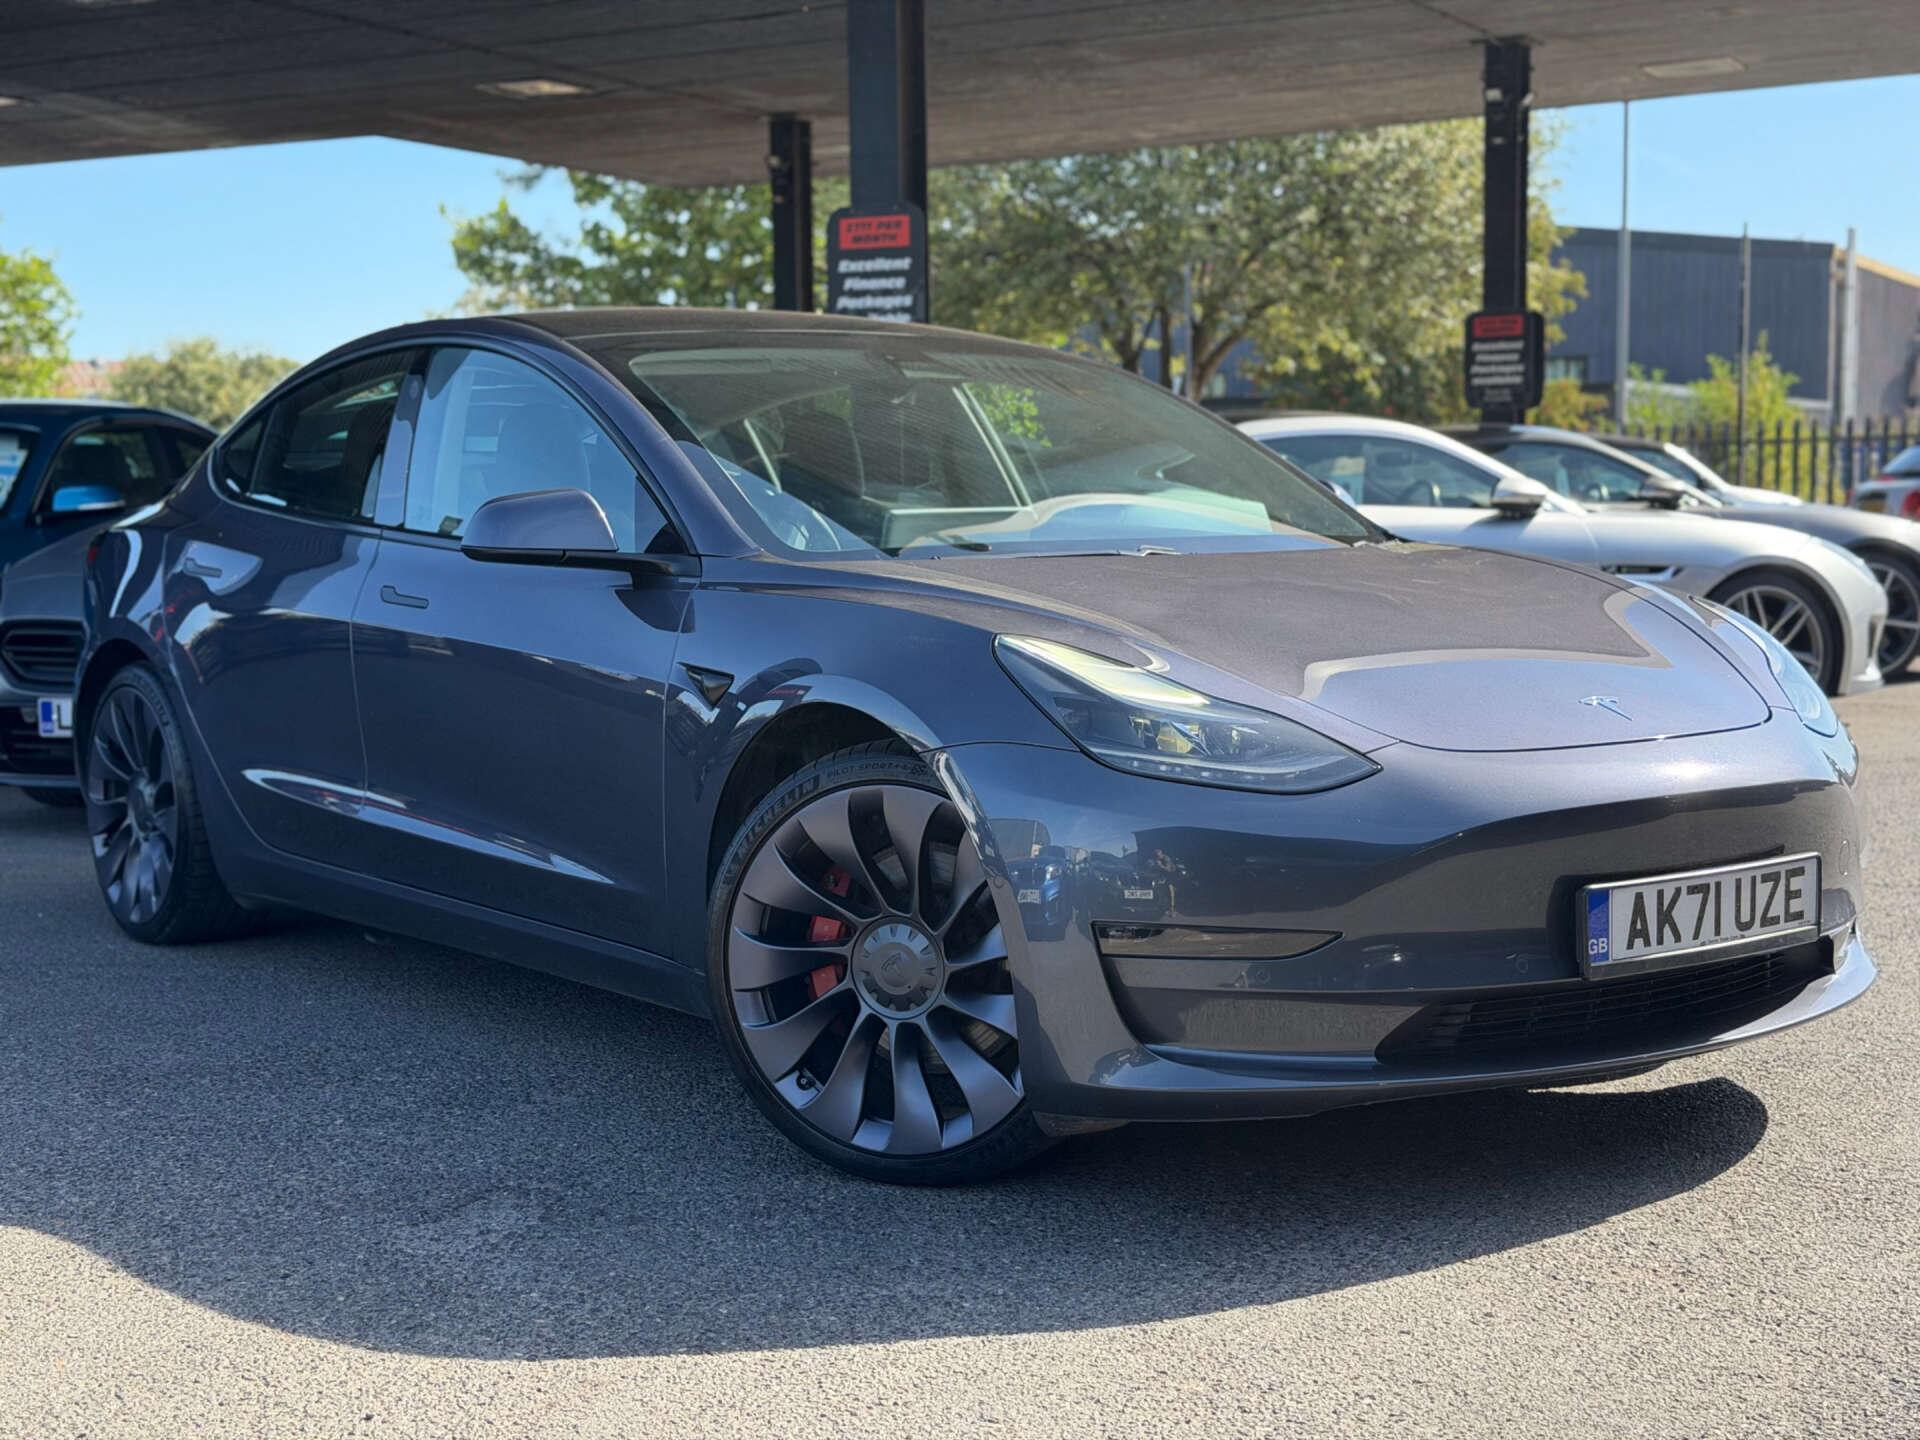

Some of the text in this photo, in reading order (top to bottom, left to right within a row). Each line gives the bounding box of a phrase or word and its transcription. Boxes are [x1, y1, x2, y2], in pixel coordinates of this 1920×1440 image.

[1627, 866, 1804, 950] AK71 UZE
[1588, 938, 1608, 955] GB
